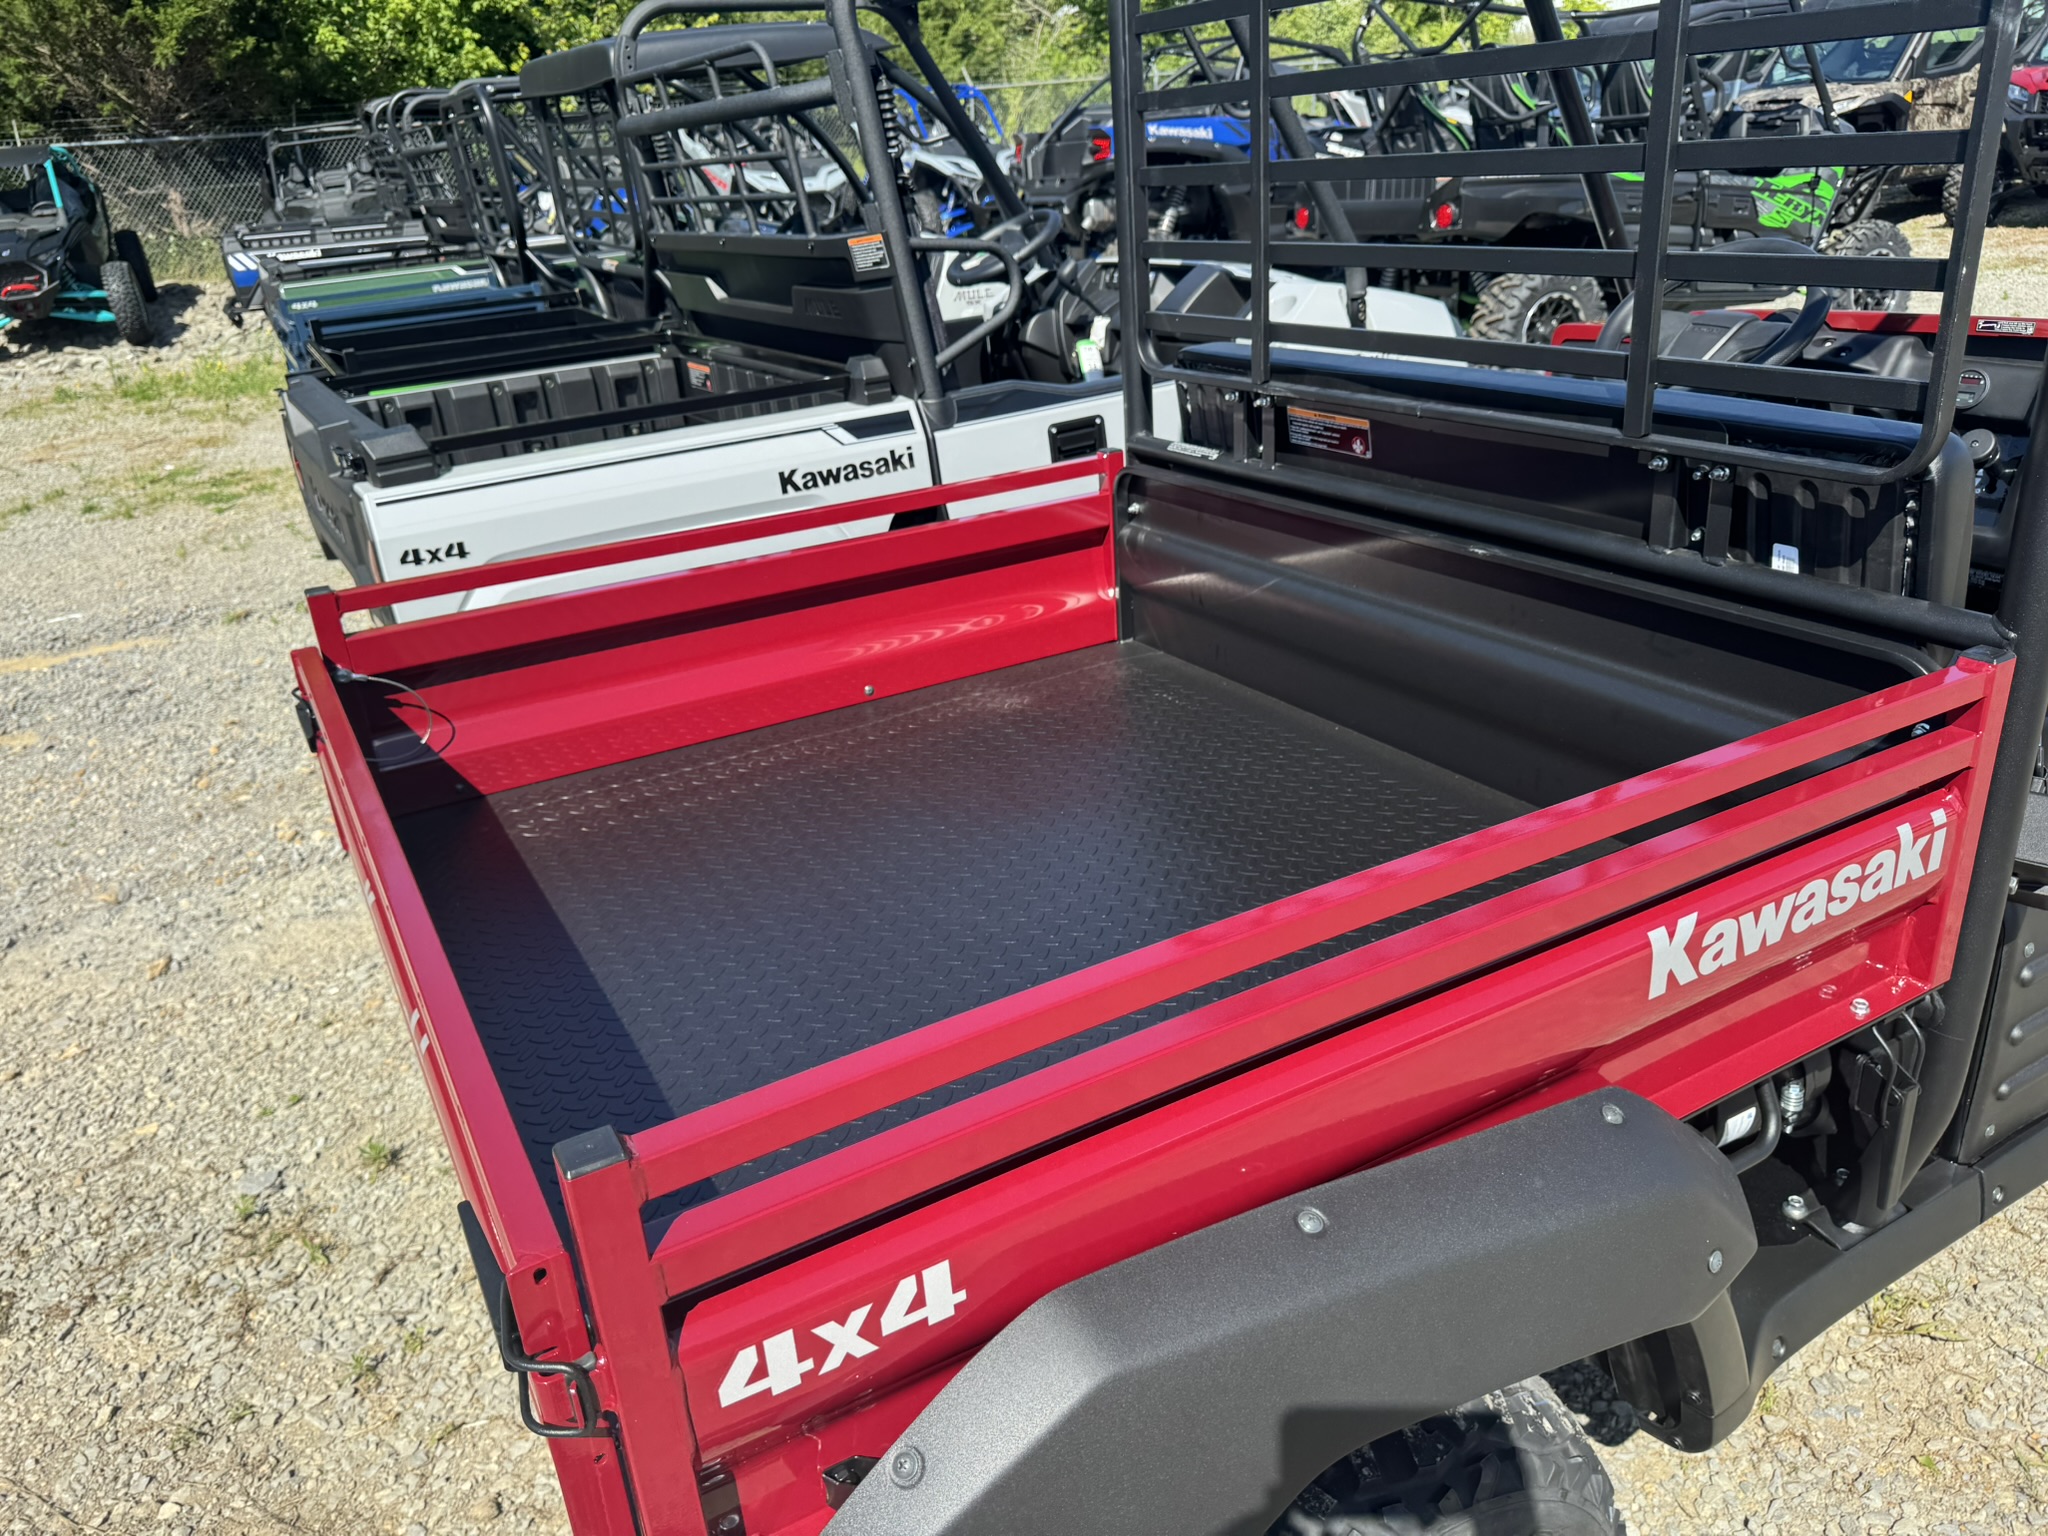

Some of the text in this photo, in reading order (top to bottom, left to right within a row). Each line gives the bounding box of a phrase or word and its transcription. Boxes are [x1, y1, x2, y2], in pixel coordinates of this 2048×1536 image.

[1147, 122, 1214, 140] Kawasaki
[953, 288, 996, 302] MULE
[778, 445, 916, 495] Kawasaki
[400, 541, 470, 566] 4x4
[1648, 807, 1947, 1000] Kawasaki
[718, 1259, 967, 1408] 4x4
